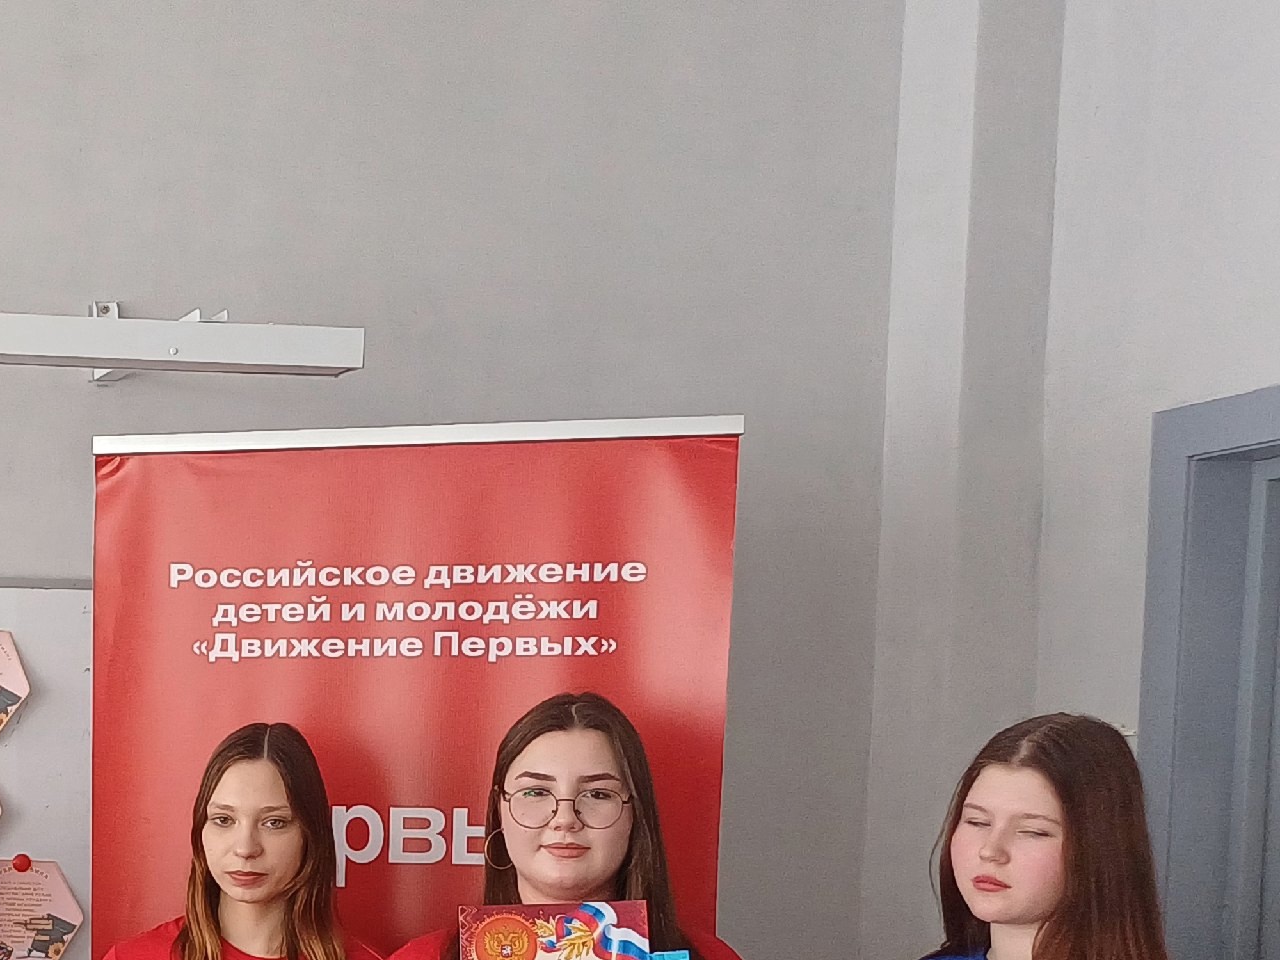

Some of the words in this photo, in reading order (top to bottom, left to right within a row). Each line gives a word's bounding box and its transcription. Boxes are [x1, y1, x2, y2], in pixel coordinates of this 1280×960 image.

[169, 560, 416, 588] Российское
[424, 561, 647, 589] движение
[211, 595, 331, 627] детей
[341, 602, 365, 622] и
[375, 593, 598, 624] молодёжи
[192, 632, 423, 662] «Движение
[433, 631, 617, 662] Первых»
